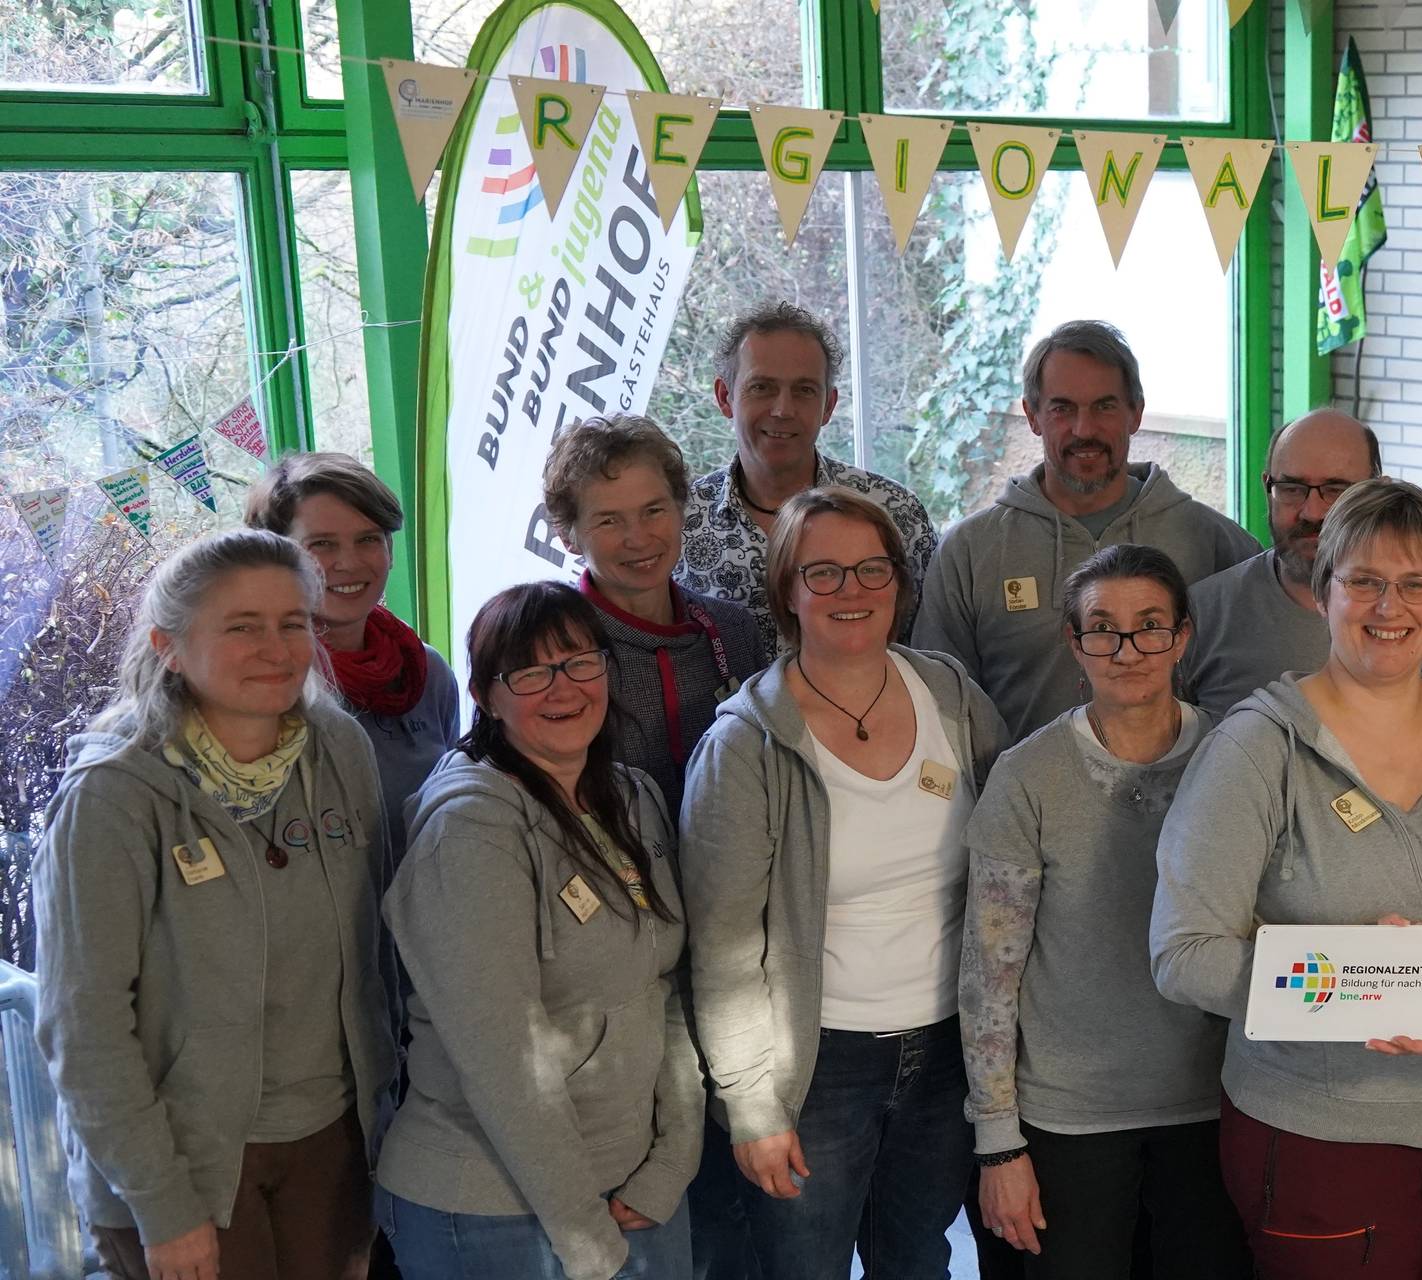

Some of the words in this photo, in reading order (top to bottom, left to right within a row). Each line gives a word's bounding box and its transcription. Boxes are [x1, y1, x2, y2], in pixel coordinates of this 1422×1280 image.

[477, 315, 529, 471] BUND
[518, 271, 545, 309] &
[619, 257, 670, 411] GÄSTEHAUS
[1339, 991, 1382, 1001] bne.nrw
[1341, 978, 1378, 989] Bildung
[1380, 978, 1395, 988] für
